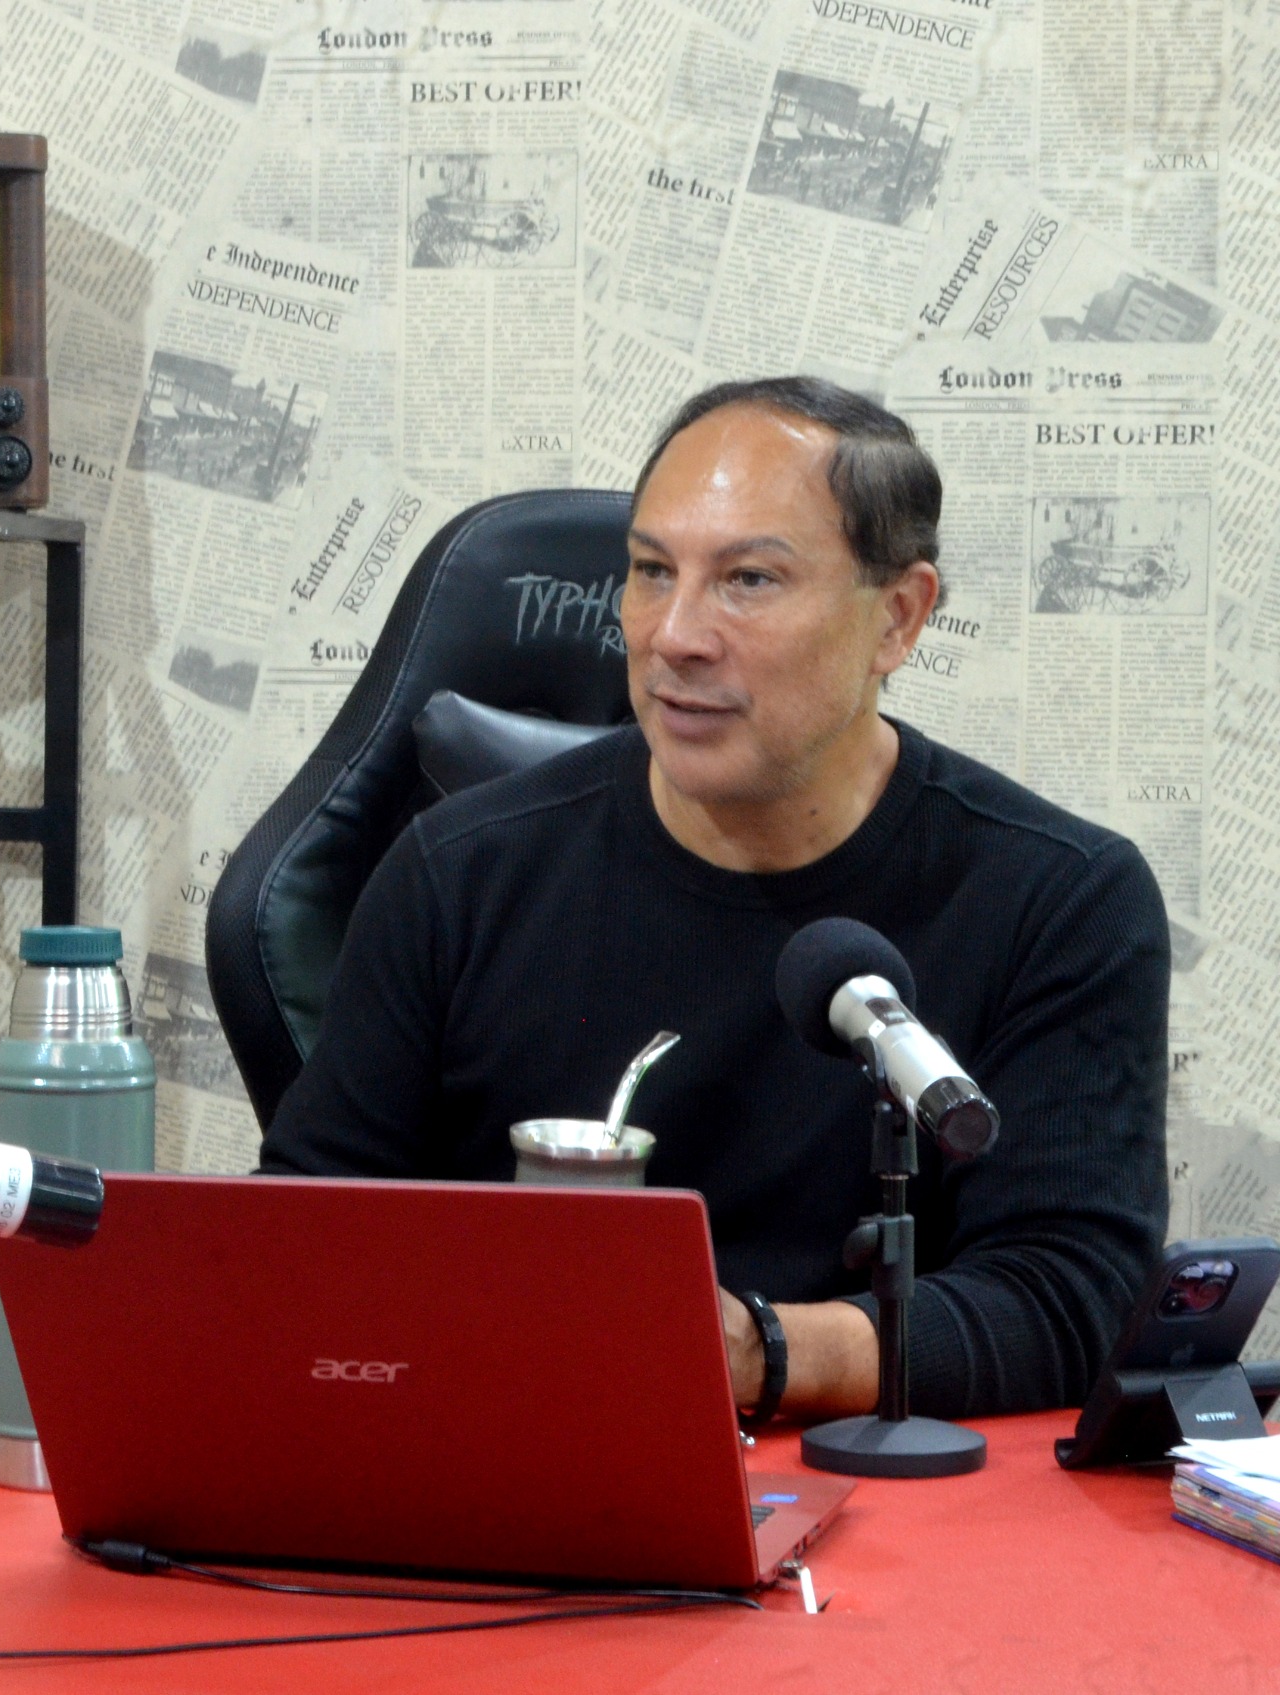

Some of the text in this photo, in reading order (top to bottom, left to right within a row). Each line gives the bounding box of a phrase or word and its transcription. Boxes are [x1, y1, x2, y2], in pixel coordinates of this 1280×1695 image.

[317, 26, 494, 54] London Press
[411, 80, 583, 104] BEST OFFER!
[647, 168, 683, 192] the
[221, 241, 360, 295] Independence
[919, 219, 999, 328] Enterprise
[973, 216, 1059, 341] RESOURCES
[939, 365, 1123, 394] London Press
[1036, 423, 1216, 446] BEST OFFER!
[290, 497, 365, 602] Enterprise
[342, 493, 422, 615] RESOURCES
[1128, 784, 1191, 801] EXTRA
[311, 1358, 410, 1383] acer
